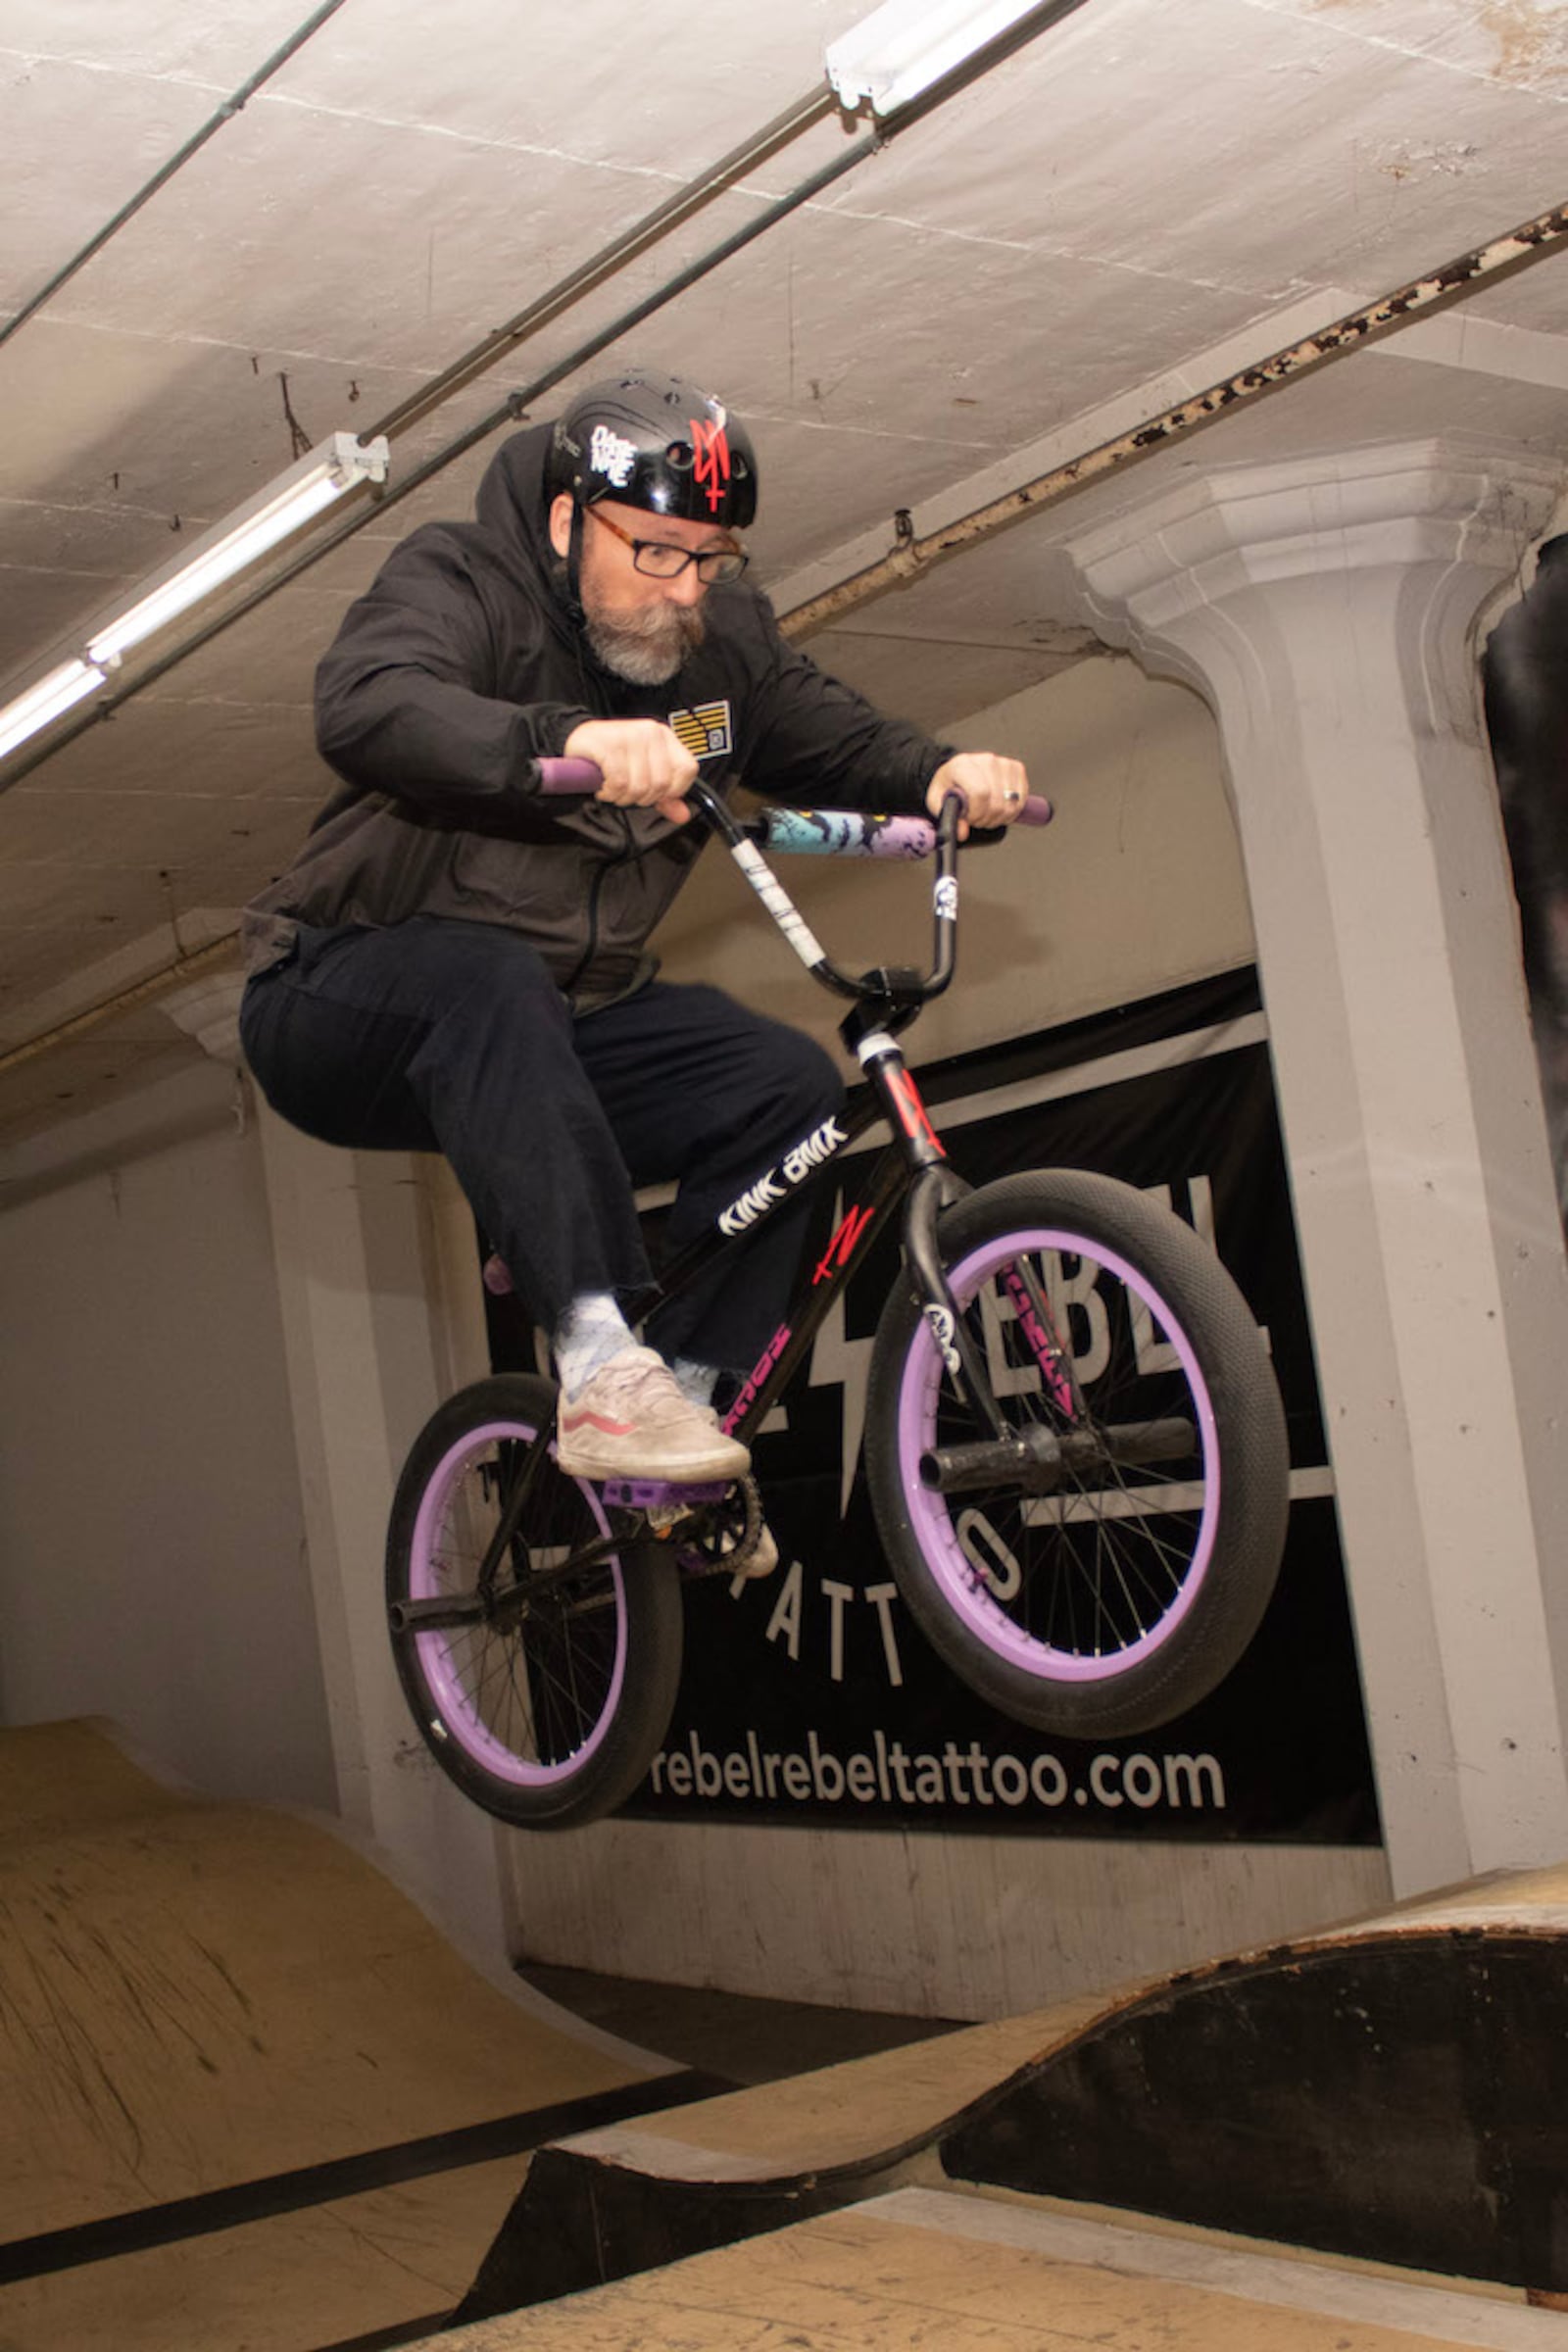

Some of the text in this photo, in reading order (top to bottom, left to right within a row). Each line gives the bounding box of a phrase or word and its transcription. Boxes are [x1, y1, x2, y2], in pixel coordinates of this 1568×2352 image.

[718, 1115, 849, 1237] KINK BMX
[730, 1507, 1022, 1687] ATTO
[651, 1730, 1226, 1808] rebelrebeltattoo.com
